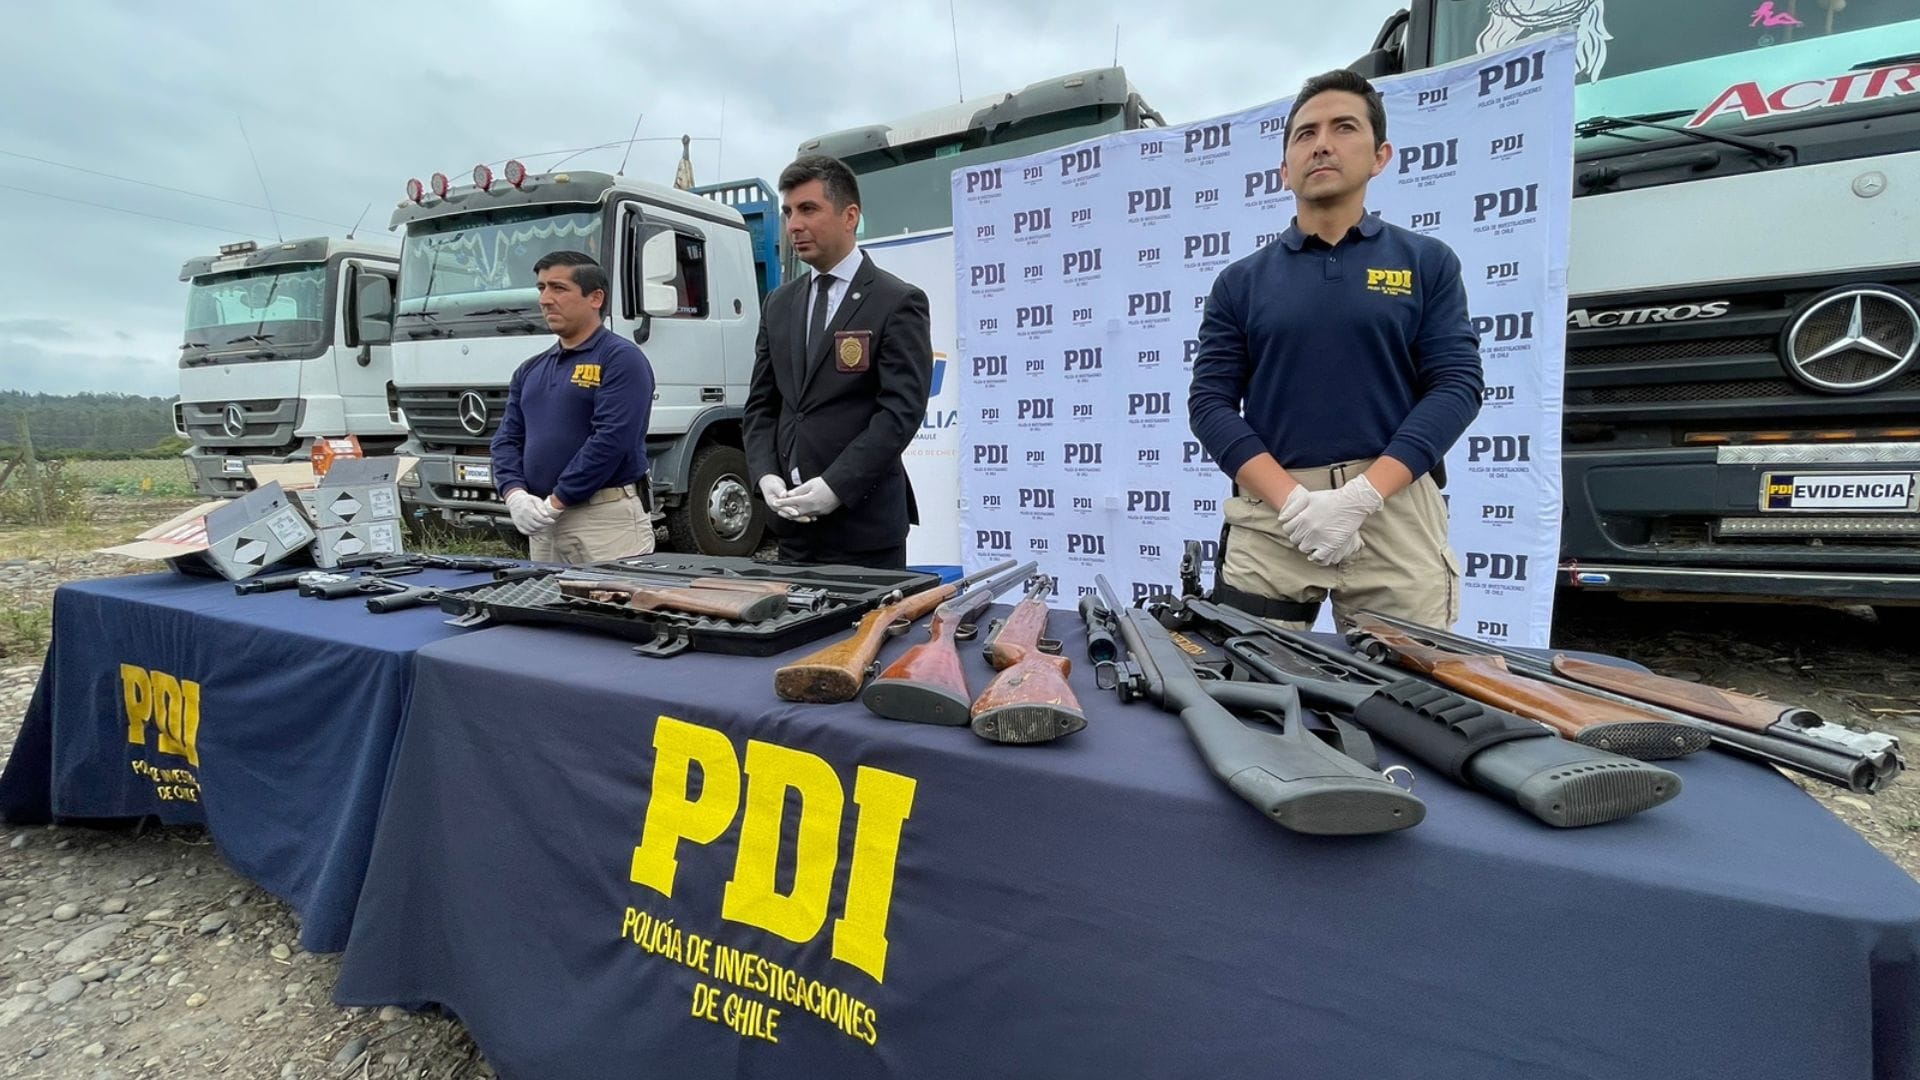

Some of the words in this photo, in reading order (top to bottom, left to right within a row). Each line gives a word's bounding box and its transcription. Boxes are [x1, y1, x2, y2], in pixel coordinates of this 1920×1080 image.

[1478, 50, 1545, 97] PDI
[1418, 87, 1448, 106] PDI
[1184, 122, 1231, 153] PDI
[1491, 134, 1524, 155] PDI
[1141, 141, 1163, 155] PDI
[1399, 138, 1458, 174] PDI
[1061, 145, 1101, 177] PDI
[966, 167, 1002, 193] PDI
[1024, 166, 1042, 180] PDI
[1128, 186, 1171, 214] PDI
[1195, 188, 1219, 204] PDI
[1473, 184, 1538, 222] PDI
[1014, 207, 1051, 234] PDI
[1071, 208, 1091, 223] PDI
[1411, 211, 1441, 228] PDI
[977, 225, 995, 238] PDI
[1138, 248, 1160, 261] PDI
[1184, 231, 1231, 259] PDI
[1024, 265, 1043, 278] PDI
[1063, 248, 1102, 275] PDI
[1487, 261, 1519, 279] PDI
[971, 262, 1006, 287] PDI
[1367, 269, 1412, 288] PDI
[1128, 290, 1171, 316] PDI
[979, 318, 998, 330] PDI
[1016, 304, 1053, 328] PDI
[1072, 308, 1092, 321] PDI
[1566, 302, 1731, 329] ACTROS
[1471, 311, 1533, 341] PDI
[972, 355, 1007, 377] PDI
[1026, 359, 1044, 371] PDI
[1064, 347, 1102, 371] PDI
[1138, 350, 1160, 362] PDI
[571, 364, 601, 381] PDI
[1483, 386, 1514, 400] PDI
[982, 408, 999, 419] PDI
[1018, 398, 1054, 419] PDI
[1073, 404, 1093, 416] PDI
[1128, 392, 1171, 415] PDI
[973, 444, 1008, 464] PDI
[1026, 451, 1045, 462] PDI
[1064, 443, 1102, 464] PDI
[1138, 450, 1159, 461] PDI
[1468, 435, 1530, 462] PDI
[983, 495, 1001, 506] PDI
[1019, 488, 1055, 509] PDI
[1127, 490, 1171, 512] PDI
[1770, 484, 1793, 495] PDI
[1794, 484, 1905, 498] EVIDENCIA
[1073, 497, 1092, 509] PDI
[1193, 499, 1217, 511] PDI
[1482, 505, 1514, 519] PDI
[976, 530, 1012, 550] PDI
[1030, 538, 1049, 549] PDI
[1067, 533, 1105, 555] PDI
[1139, 544, 1161, 556] PDI
[1465, 552, 1528, 581] PDI
[1477, 621, 1508, 636] PDI
[120, 663, 200, 768] PDI
[630, 715, 917, 984] PDI
[622, 907, 682, 963] POLICÍA
[687, 934, 712, 974] DE
[714, 945, 878, 1046] INVESTIGACIONES
[691, 982, 719, 1022] DE
[723, 993, 781, 1044] CHILE
